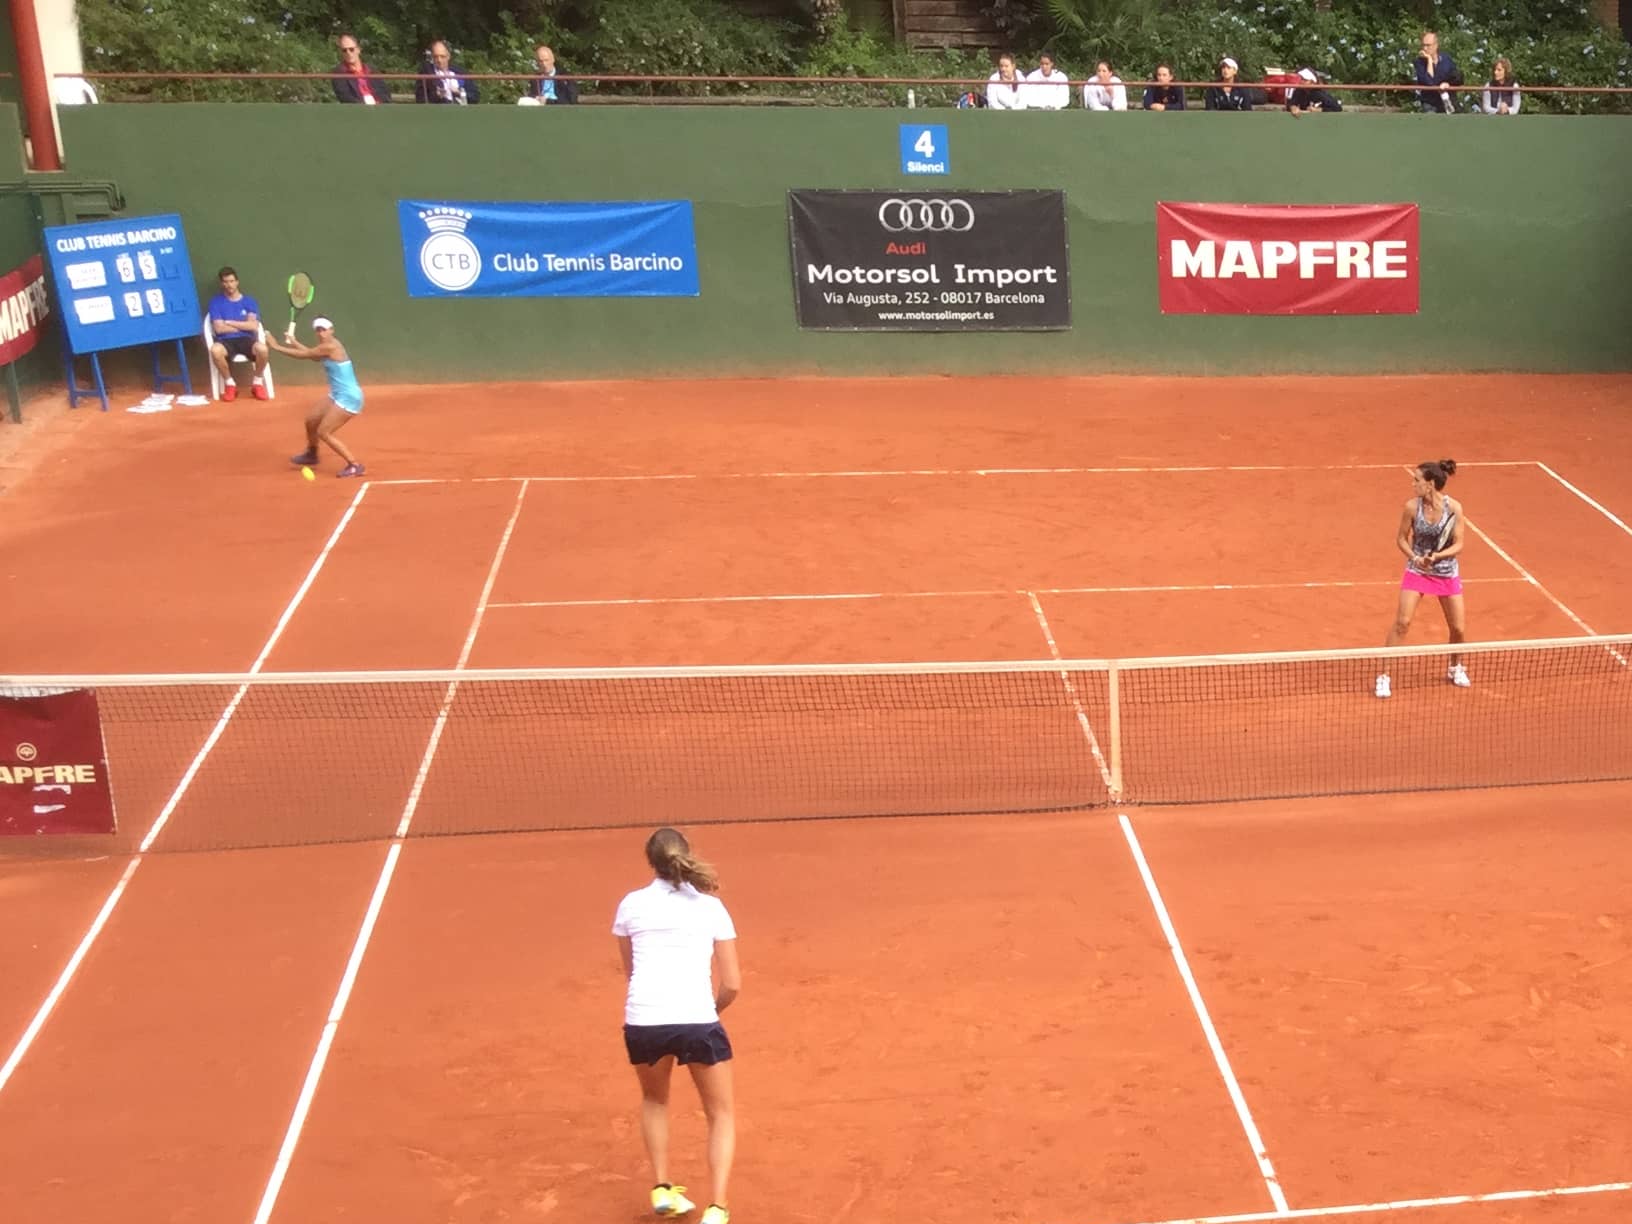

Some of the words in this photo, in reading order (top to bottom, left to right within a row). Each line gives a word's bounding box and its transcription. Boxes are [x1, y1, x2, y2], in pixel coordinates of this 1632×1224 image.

[914, 130, 935, 158] 4
[56, 237, 85, 252] CLUB
[86, 232, 126, 249] TENNIS
[127, 226, 176, 245] BARCINO
[885, 241, 927, 255] Audi
[431, 253, 471, 270] CTB
[493, 253, 538, 272] Club
[543, 253, 605, 272] Tennis
[610, 253, 683, 271] Barcino
[1171, 239, 1407, 279] MAPFRE
[807, 263, 940, 284] Motorsol
[953, 263, 1057, 288] Import
[823, 292, 843, 304] Via
[847, 292, 902, 307] Augusta,
[905, 292, 930, 304] 252
[940, 292, 981, 304] 08017
[985, 292, 1045, 304] Barcelona
[878, 310, 994, 321] www.motorsolimport.es
[0, 764, 97, 784] APFRE
